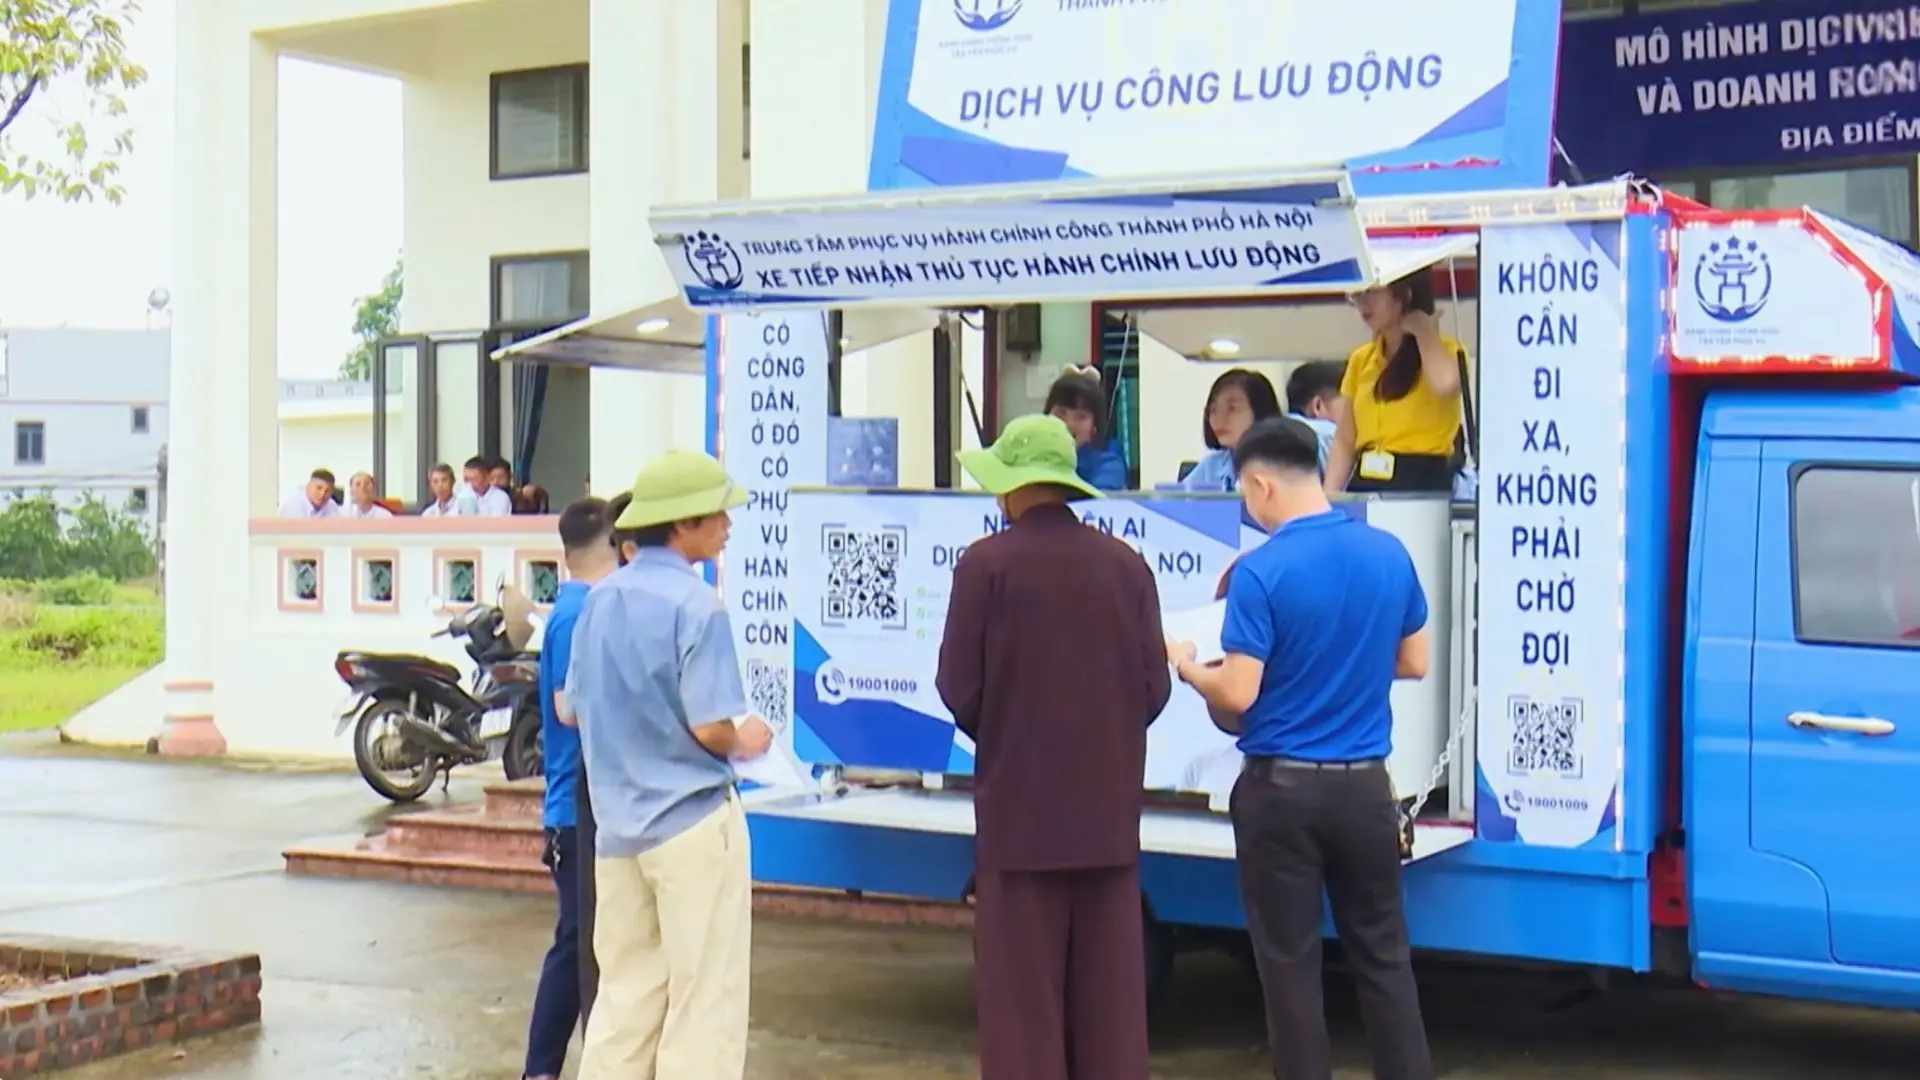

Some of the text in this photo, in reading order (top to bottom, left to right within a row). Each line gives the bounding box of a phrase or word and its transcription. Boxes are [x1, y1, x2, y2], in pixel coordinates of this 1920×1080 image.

[1615, 27, 1671, 68] MÔ
[1682, 21, 1769, 61] HÌNH
[958, 50, 1443, 129] DỊCH VỤ CÔNG LƯU ĐỘNG
[1637, 76, 1683, 116] VÀ
[1693, 70, 1817, 111] DOANH
[1780, 111, 1920, 152] ĐỊA ĐIỂM
[742, 207, 1313, 256] TRUNG TÂM PHỤC VỤ HÀNH CHÍNH CÔNG THÀNH PHỐ HÀ NỘI
[756, 240, 1321, 289] XE TIẾP NHẬN THỦ TỤC HÀNH CHÍNH LƯU ĐỘNG
[1498, 253, 1599, 294] KHÔNG
[763, 319, 790, 345] CÓ
[1517, 301, 1577, 347] CẦN
[748, 352, 805, 379] CÔNG
[751, 385, 800, 413] DÂN,
[1534, 366, 1561, 400] ĐI
[751, 418, 800, 445] Ở ĐÓ
[1522, 420, 1570, 456] XA,
[761, 451, 789, 479] CÓ
[1496, 465, 1597, 506] KHÔNG
[747, 489, 788, 517] PHỤ
[761, 524, 788, 551] VỤ
[1123, 517, 1146, 539] AI
[1511, 516, 1580, 558] PHẢI
[745, 553, 788, 578] HÀN
[933, 545, 969, 571] DỊC
[1158, 551, 1202, 578] NỘI
[742, 586, 788, 612] CHÍN
[1517, 572, 1575, 613] CHỜ
[745, 619, 788, 645] CÔN
[1522, 631, 1570, 675] ĐỢI
[848, 677, 917, 694] 19001009
[1528, 797, 1589, 811] 19001009
